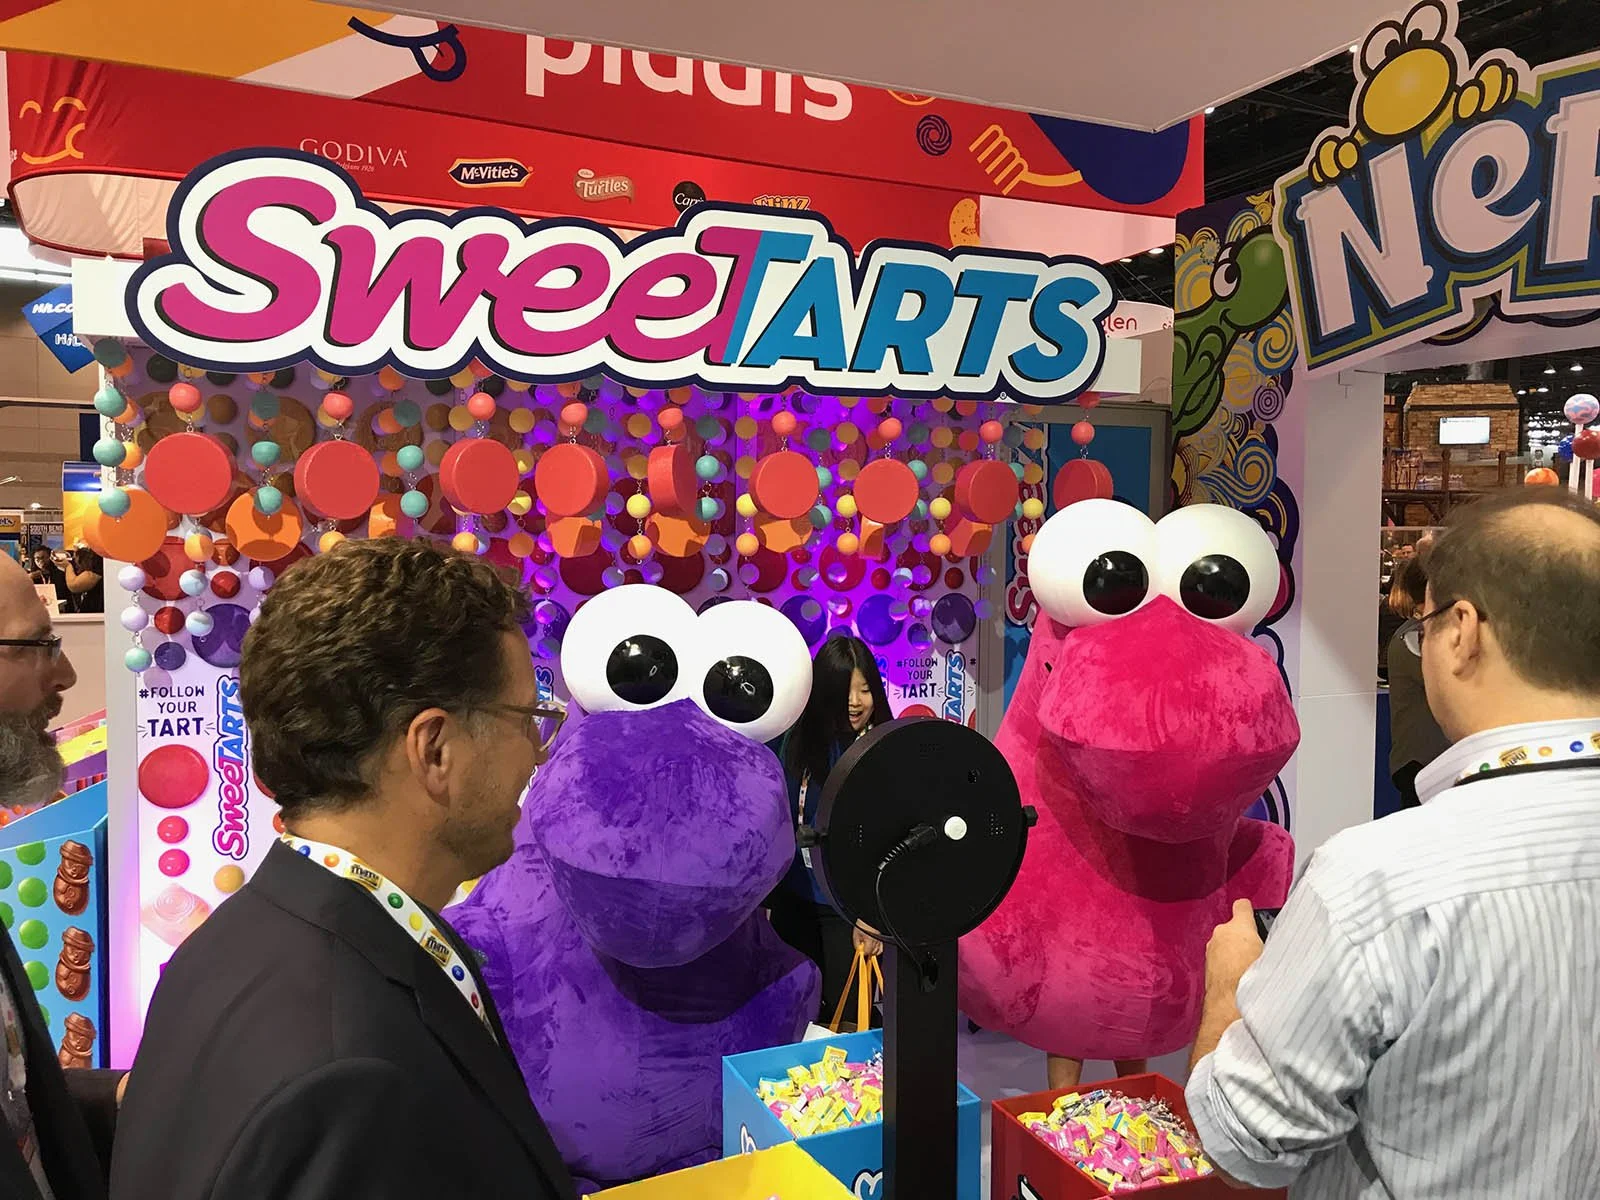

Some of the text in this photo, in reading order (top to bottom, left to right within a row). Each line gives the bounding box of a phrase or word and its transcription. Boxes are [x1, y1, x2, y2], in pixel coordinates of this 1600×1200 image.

[300, 138, 406, 168] GODIVA
[461, 165, 519, 181] McVitie's
[576, 179, 629, 198] Turtles
[157, 176, 1099, 382] SweeTARTS
[896, 658, 938, 669] #FOLLOW
[907, 670, 933, 681] YOUR
[139, 686, 205, 699] #FOLLOW
[901, 683, 937, 699] TART
[157, 701, 197, 714] YOUR
[147, 717, 204, 738] TART
